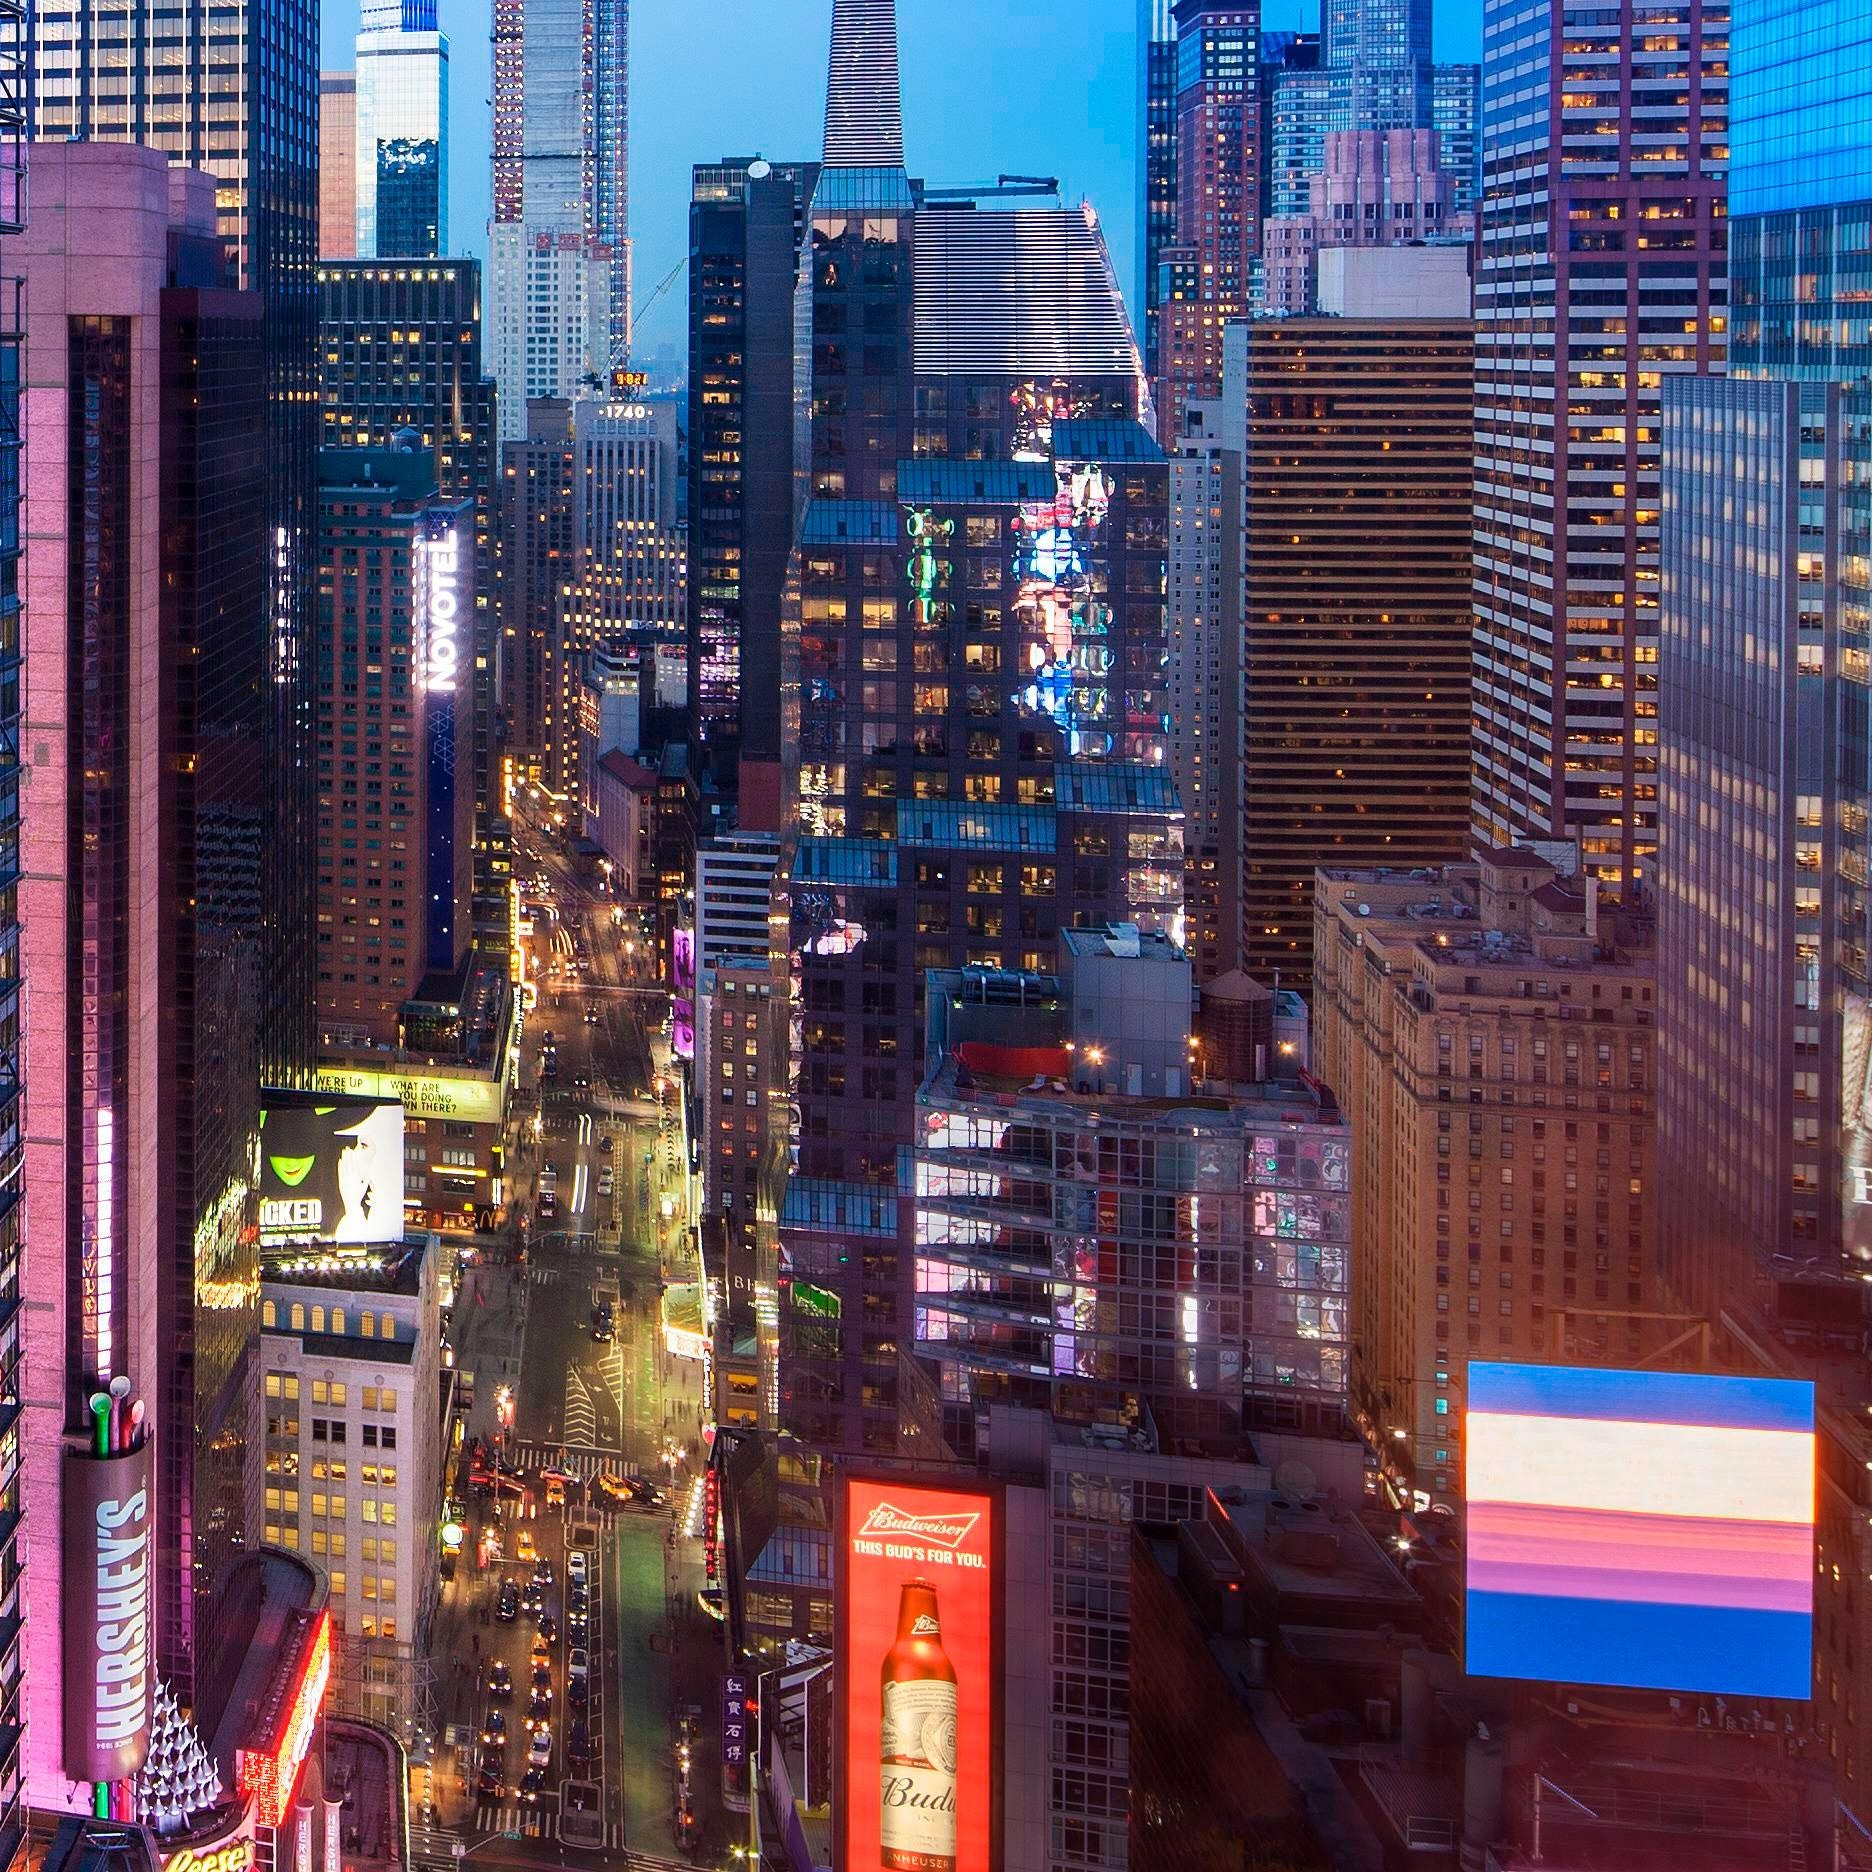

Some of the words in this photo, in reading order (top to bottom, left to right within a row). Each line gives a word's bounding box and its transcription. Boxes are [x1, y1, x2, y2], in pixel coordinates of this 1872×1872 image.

[605, 405, 646, 419] 1740
[428, 529, 457, 690] NOVOTEL
[349, 1076, 363, 1088] UP
[390, 1080, 418, 1092] WHAT
[421, 1082, 440, 1093] ARE
[398, 1090, 417, 1101] YOU
[421, 1092, 452, 1103] DOING
[421, 1102, 457, 1113] THERE?
[259, 1196, 322, 1226] ICKED
[869, 1509, 967, 1536] Budweiser
[853, 1539, 883, 1556] THIS
[885, 1544, 925, 1561] BUD'S
[927, 1549, 953, 1565] FOR
[956, 1553, 987, 1568] YOU.
[96, 1488, 147, 1741] HERSHEY'S
